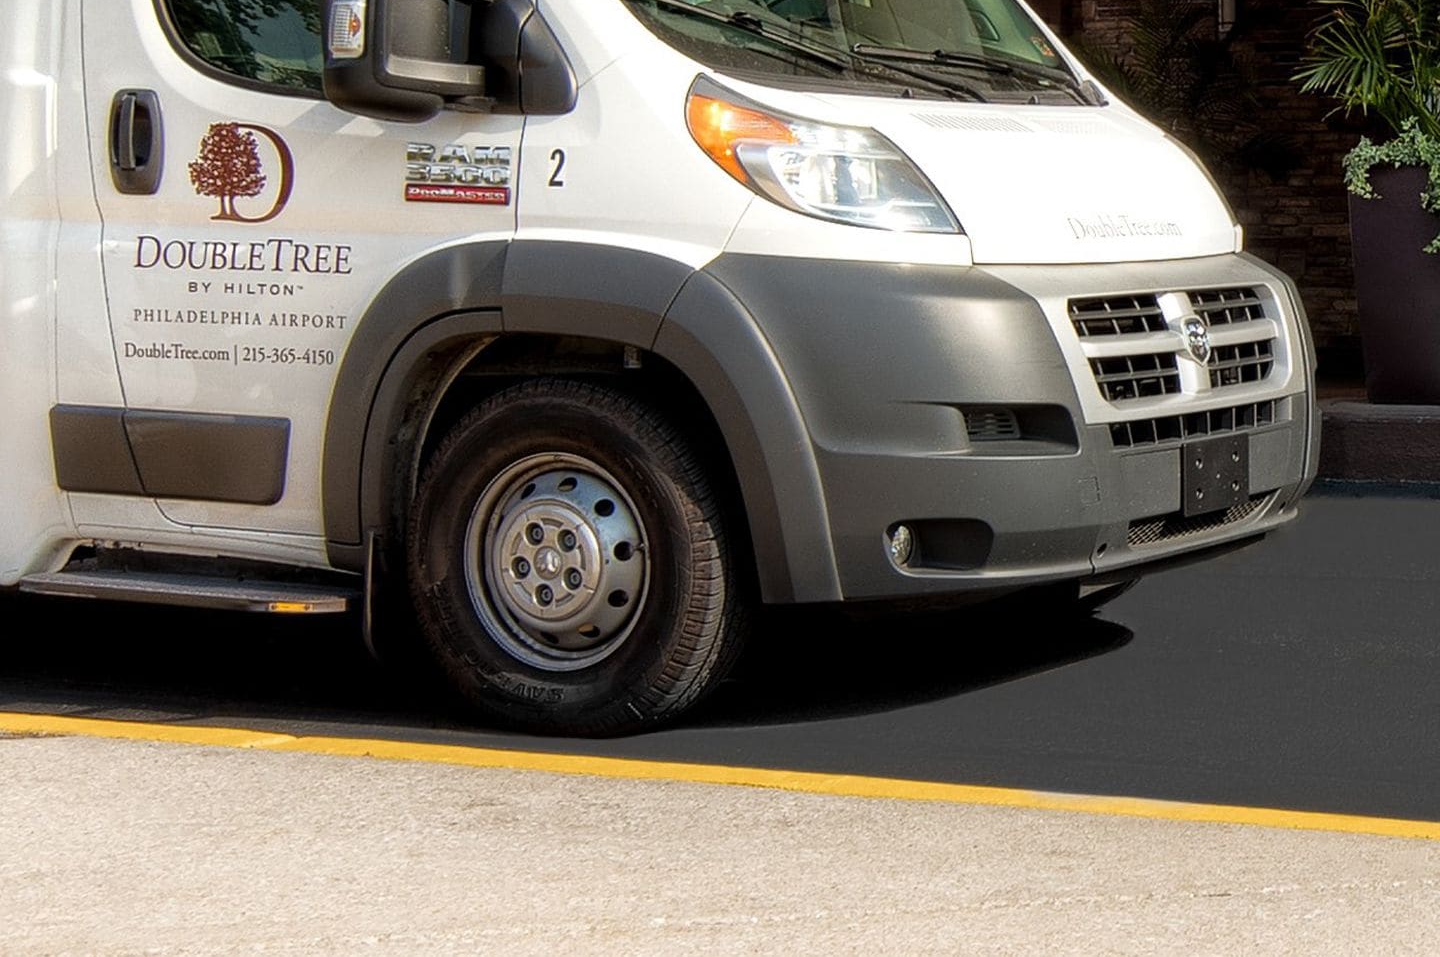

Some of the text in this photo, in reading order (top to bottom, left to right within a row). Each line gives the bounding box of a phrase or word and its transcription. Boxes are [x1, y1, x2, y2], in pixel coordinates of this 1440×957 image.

[406, 142, 510, 164] RAM
[405, 163, 510, 185] 3500
[548, 148, 565, 187] 2
[188, 281, 212, 293] BY
[133, 309, 348, 330] PHILADELPHIA AIRPORT
[124, 342, 335, 365] DoubleTree.com 215-365-4150
